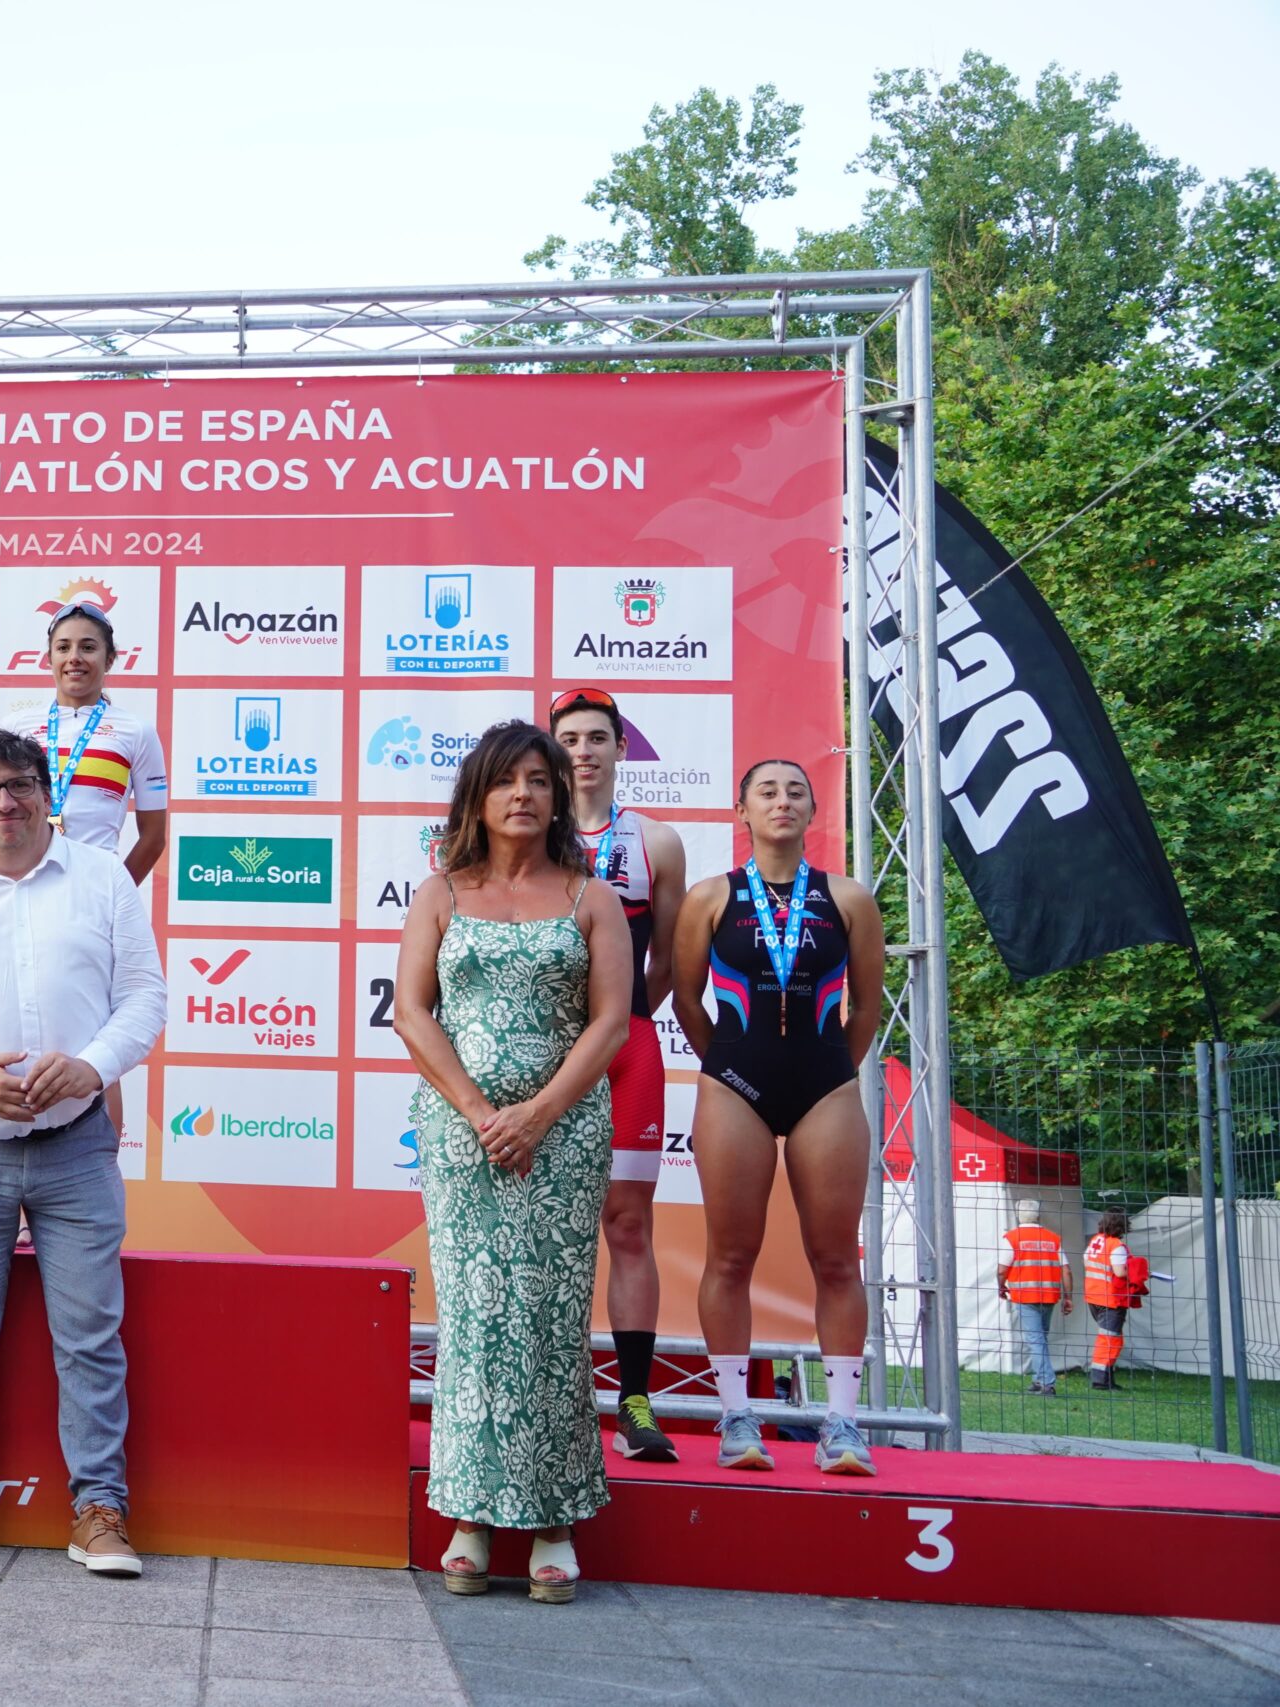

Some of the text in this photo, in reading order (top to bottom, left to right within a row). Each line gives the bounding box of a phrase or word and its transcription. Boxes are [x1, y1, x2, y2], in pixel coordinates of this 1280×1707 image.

[123, 410, 184, 442] DE
[200, 400, 393, 442] ESPAÑA
[180, 459, 308, 491] CROS
[325, 458, 356, 491] Y
[370, 448, 646, 491] ACUATLÓN
[123, 532, 204, 556] 2024
[182, 601, 338, 633] Almazán
[258, 636, 338, 645] Ven Vive Vuelve
[386, 629, 510, 652] LOTERÍAS
[573, 633, 708, 659] Almazán
[399, 660, 496, 671] CON EL DEPORTE
[595, 662, 693, 673] AYUNTAMIENTO
[431, 732, 480, 750] Soria
[196, 753, 318, 775] LOTERÍAS
[209, 783, 304, 793] CON EL DEPORTE
[632, 786, 683, 803] Soria
[188, 864, 321, 887] Caja rural de Soria
[186, 995, 317, 1027] Halcón
[254, 1030, 316, 1050] viajes
[220, 1114, 335, 1141] Iberdrola
[667, 1156, 693, 1167] Vive
[904, 1507, 955, 1573] 3
